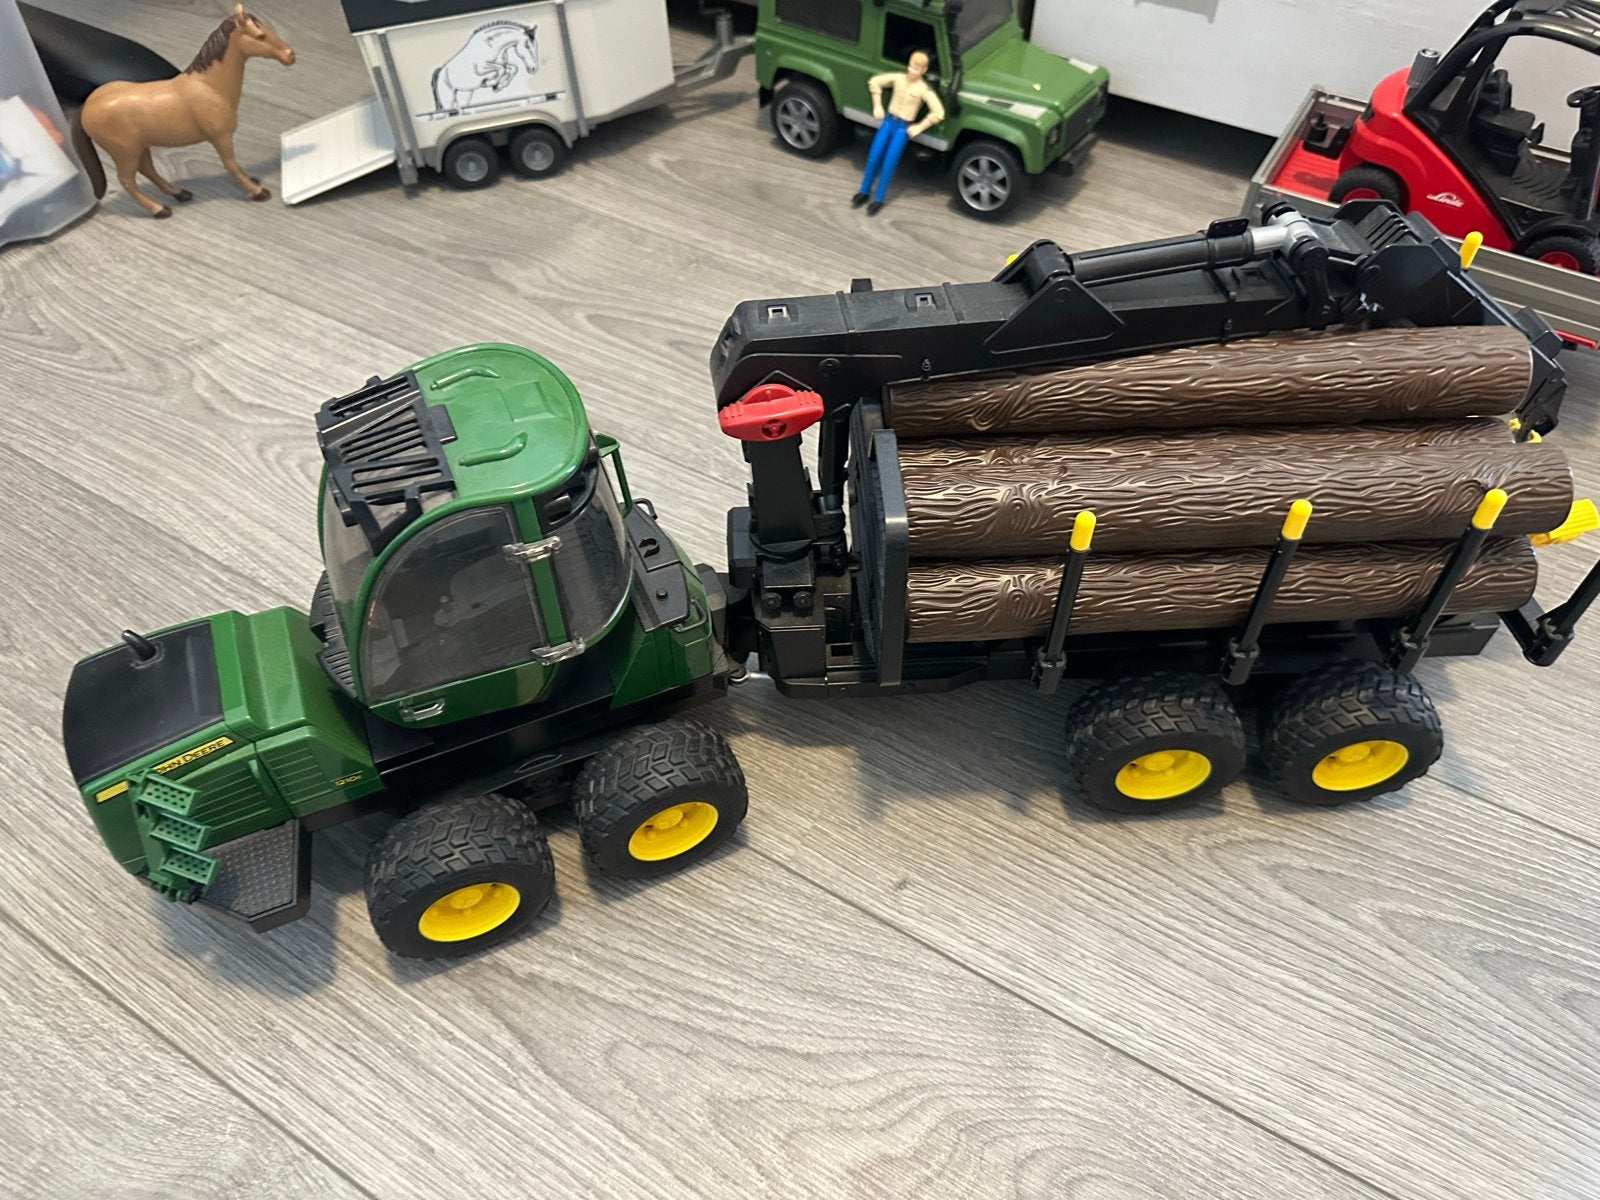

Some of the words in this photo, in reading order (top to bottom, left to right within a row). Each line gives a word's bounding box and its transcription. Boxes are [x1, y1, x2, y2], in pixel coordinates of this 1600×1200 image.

[1426, 192, 1464, 208] Linde
[154, 759, 182, 775] OHN
[183, 739, 224, 763] DEERE
